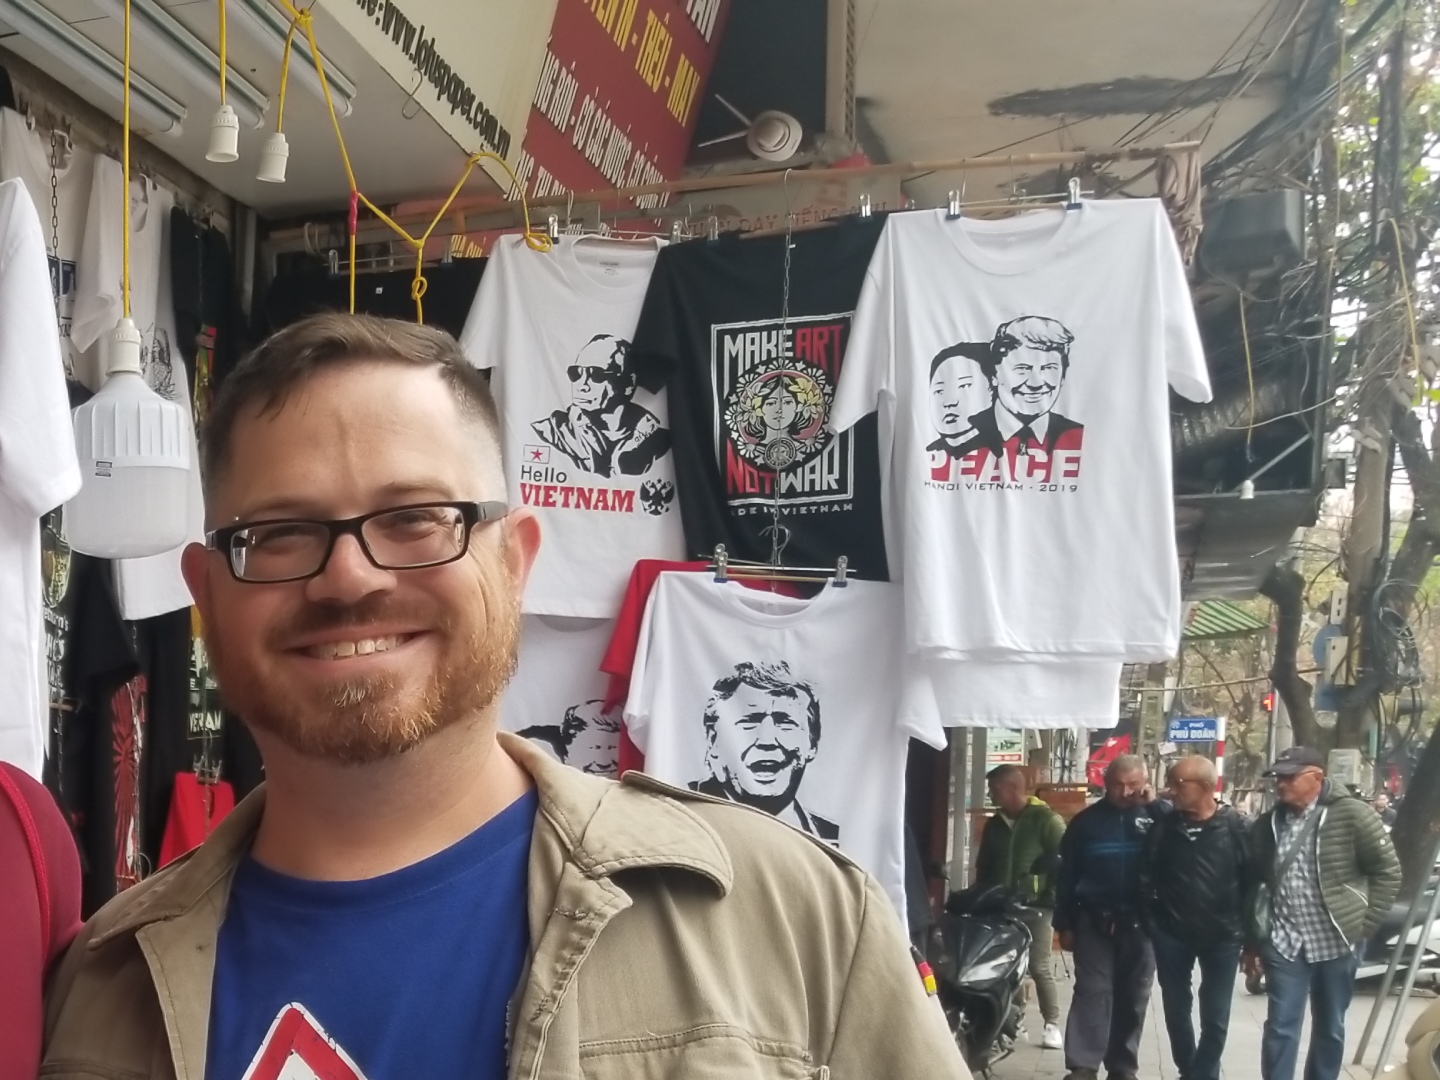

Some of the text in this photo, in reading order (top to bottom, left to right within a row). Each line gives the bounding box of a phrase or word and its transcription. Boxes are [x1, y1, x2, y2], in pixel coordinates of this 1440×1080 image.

[356, 0, 511, 161] e:www.lotuspaper.com.vn
[533, 48, 560, 114] NG
[666, 53, 701, 127] MAY
[724, 325, 844, 400] MAKE ART
[520, 464, 568, 484] Hello
[726, 434, 840, 496] NOT WAR
[924, 480, 960, 491] HANOI
[965, 482, 1024, 491] VIETNAM
[1039, 484, 1078, 493] 2019
[929, 446, 1082, 483] PEACE
[520, 482, 636, 513] VIETNAM
[781, 502, 854, 516] VIETNAM
